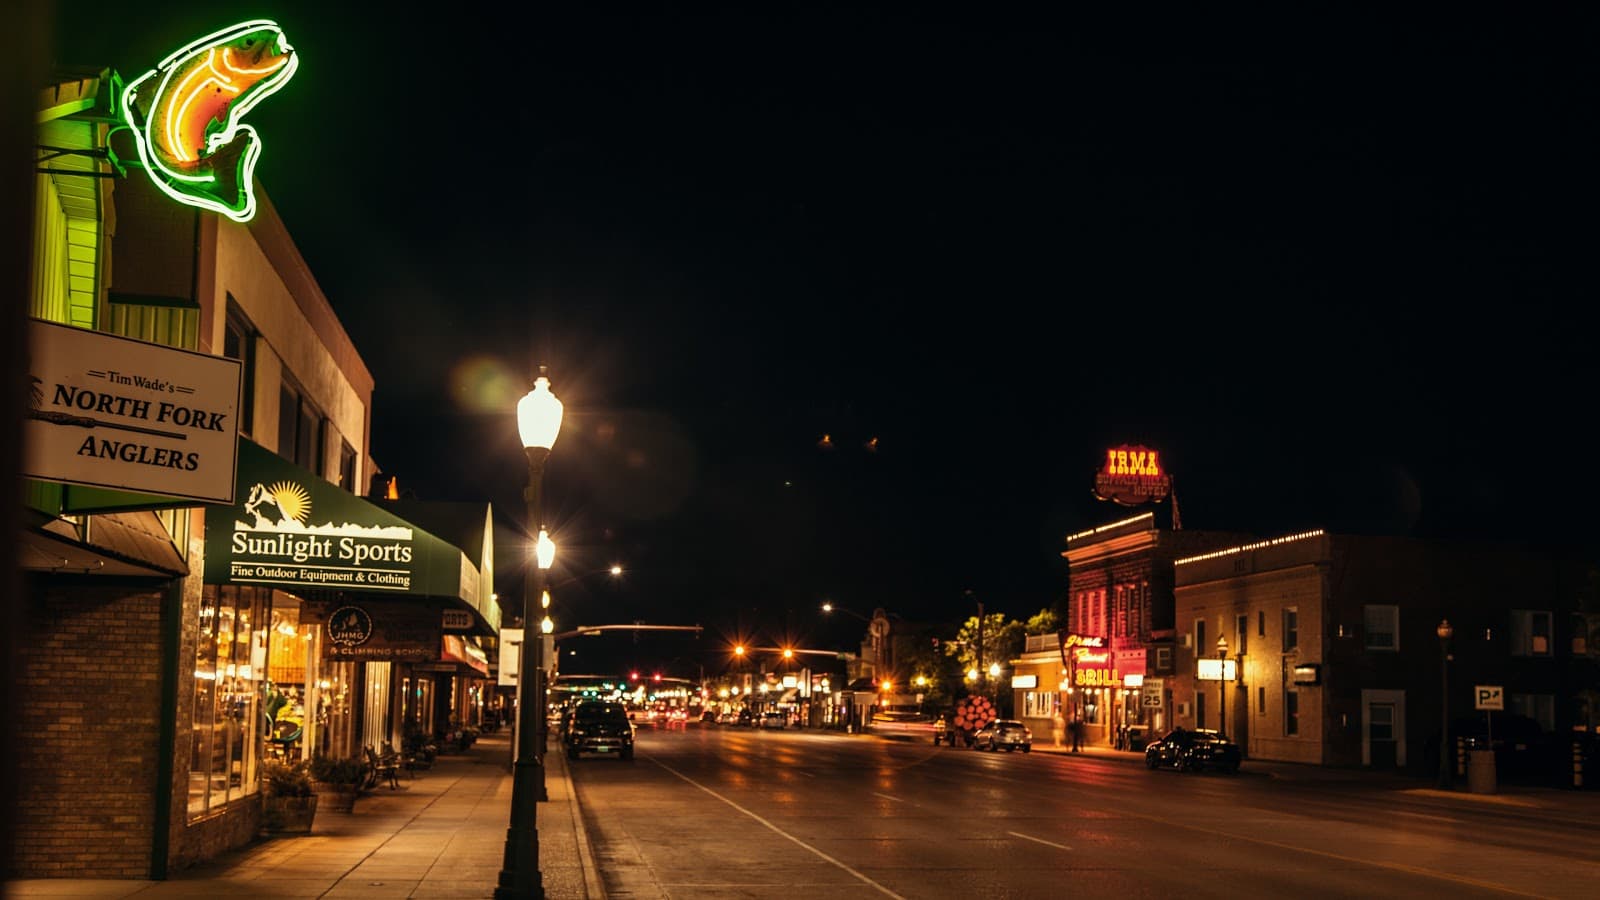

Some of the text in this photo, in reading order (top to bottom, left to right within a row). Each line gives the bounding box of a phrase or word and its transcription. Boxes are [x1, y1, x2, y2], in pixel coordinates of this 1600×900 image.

[107, 370, 175, 394] Tim Wade's
[52, 383, 227, 432] NORTH FORK
[77, 435, 200, 471] ANGLERS
[1109, 449, 1159, 476] IRMA
[232, 531, 412, 565] Sunlight Sports
[231, 566, 410, 586] Fine Outdoor Equipment & Clothing
[335, 631, 364, 640] JHMG
[341, 647, 392, 656] CLIMBING
[1075, 668, 1121, 686] GRILL
[1144, 695, 1161, 706] 25
